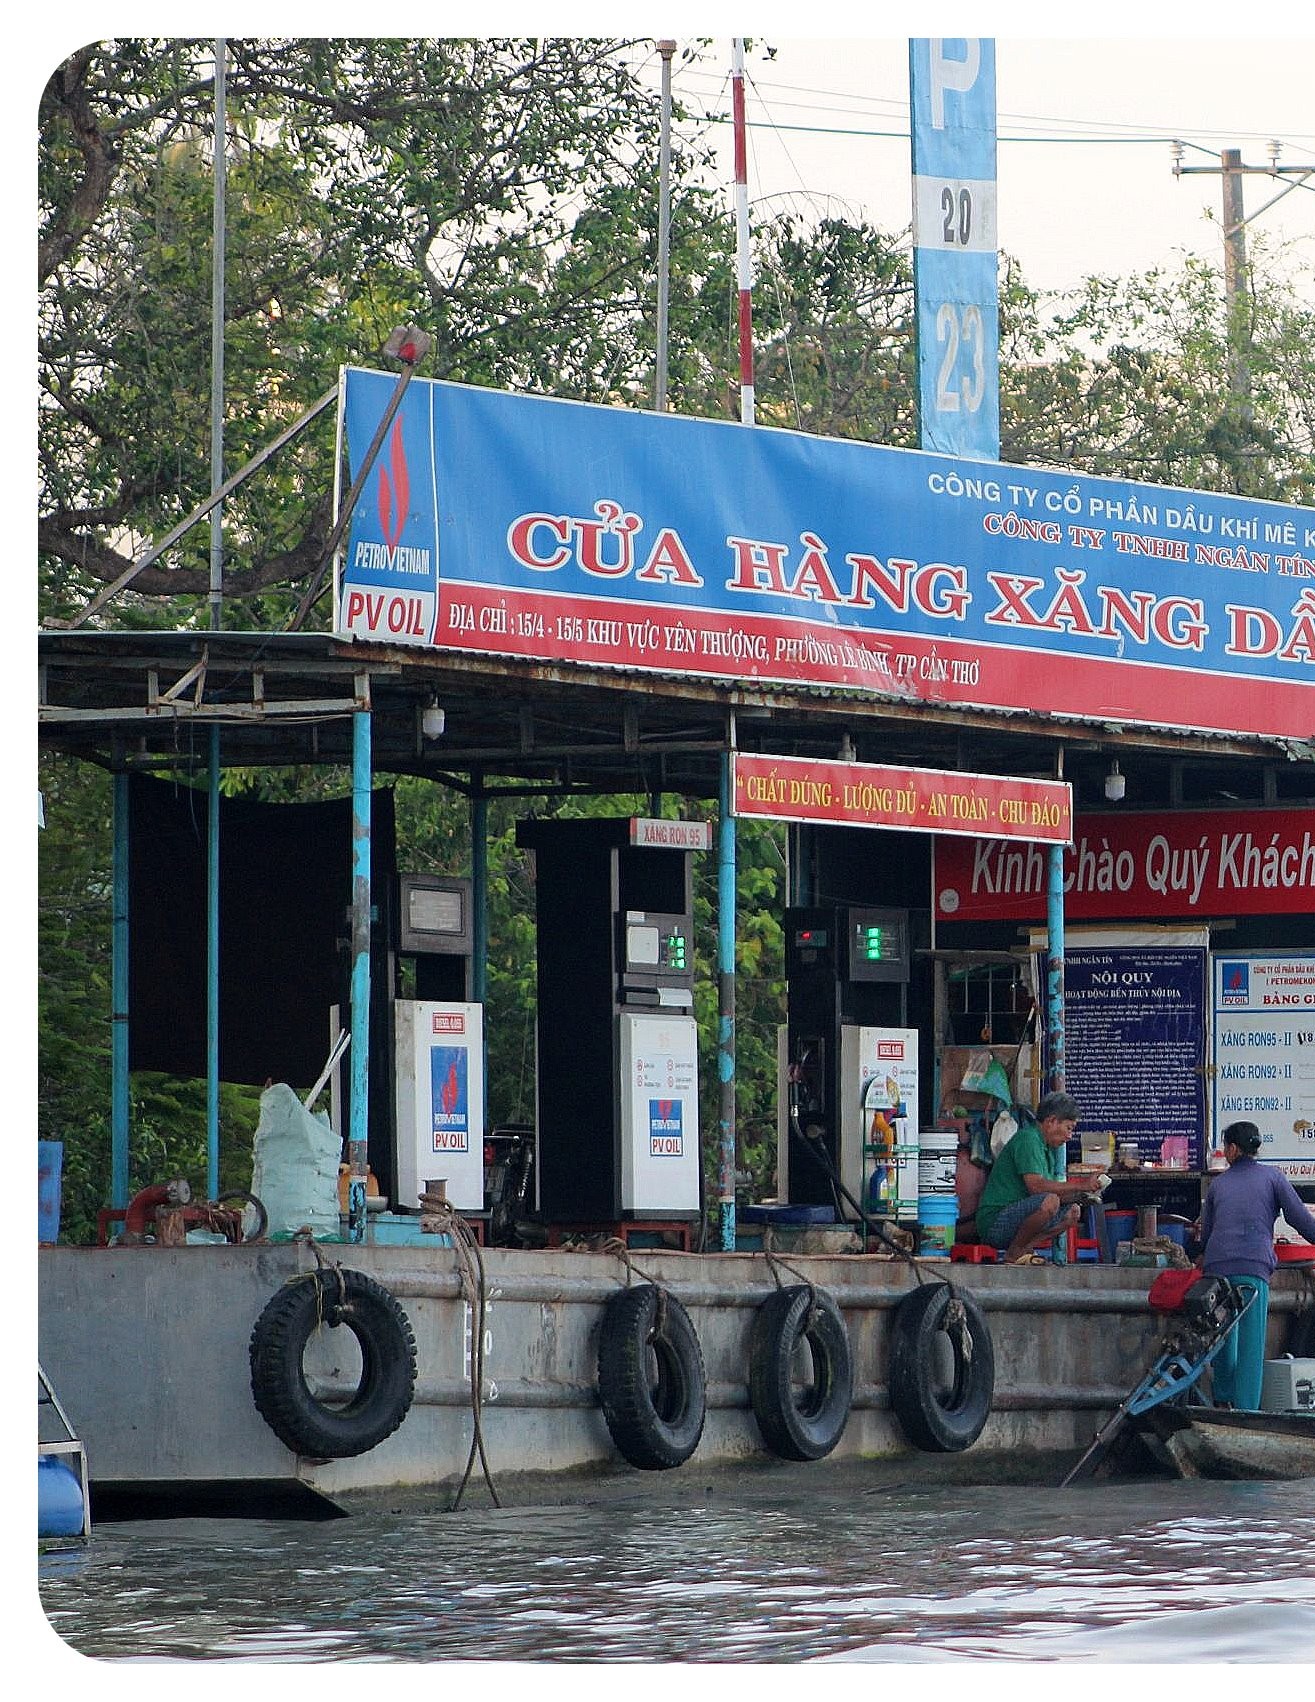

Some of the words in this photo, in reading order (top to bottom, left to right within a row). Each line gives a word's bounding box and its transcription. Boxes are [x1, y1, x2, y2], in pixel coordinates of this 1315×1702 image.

[930, 38, 981, 130] P
[941, 186, 972, 246] 20
[936, 302, 986, 413] 23
[928, 471, 1000, 502] CÔNG
[1007, 485, 1039, 507] TY
[1045, 484, 1082, 515] CỔ
[1089, 494, 1158, 527] PHẦN
[1165, 504, 1214, 534] DẦU
[1220, 517, 1258, 541] KHÍ
[1264, 521, 1297, 546] MÊ
[355, 542, 431, 576] PETROVIETNAM
[983, 511, 1062, 544] CÔNG
[1068, 525, 1106, 550] TY
[1113, 531, 1189, 562] TNHH
[1195, 543, 1271, 574] NGÂN
[507, 499, 704, 588] CỬA
[725, 531, 972, 622] HÀNG
[984, 567, 1210, 653] XĂNG
[347, 591, 385, 631] PV
[387, 597, 426, 636] OIL
[449, 603, 476, 635] ĐỊA
[479, 598, 507, 633] CHỈ
[517, 612, 545, 638] 15/4
[556, 616, 583, 641] 15/5
[586, 618, 621, 647] KHU
[628, 619, 660, 653] VỰC
[664, 620, 697, 653] YÊN
[700, 627, 770, 664] THƯỢNG,
[774, 633, 838, 665] PHƯỜNG
[896, 654, 917, 678] TP
[919, 644, 949, 681] CẦN
[951, 656, 980, 686] THƠ
[747, 768, 787, 802] CHẤT
[790, 774, 832, 807] ĐÚNG
[844, 780, 893, 816] LƯỢNG
[896, 781, 917, 814] ĐỦ
[928, 792, 947, 817] AN
[951, 788, 988, 821] TOÀN
[1000, 799, 1028, 824] CHU
[1031, 797, 1061, 828] ĐÁO
[669, 826, 688, 844] RON
[690, 828, 701, 846] 95
[971, 839, 1043, 894] Kính
[1145, 834, 1210, 904] Quý
[1091, 970, 1118, 985] NỘI
[1121, 972, 1154, 985] QUY
[1263, 990, 1300, 1005] BẢNG
[1221, 1030, 1246, 1046] XĂNG
[1248, 1032, 1277, 1046] RON95
[1221, 1062, 1246, 1079] XĂNG
[1248, 1064, 1277, 1079] RON92
[1254, 1097, 1279, 1111] RON92
[435, 1133, 448, 1149] PV
[450, 1133, 466, 1149] OIL
[652, 1138, 664, 1153] PV
[666, 1138, 681, 1153] OIL
